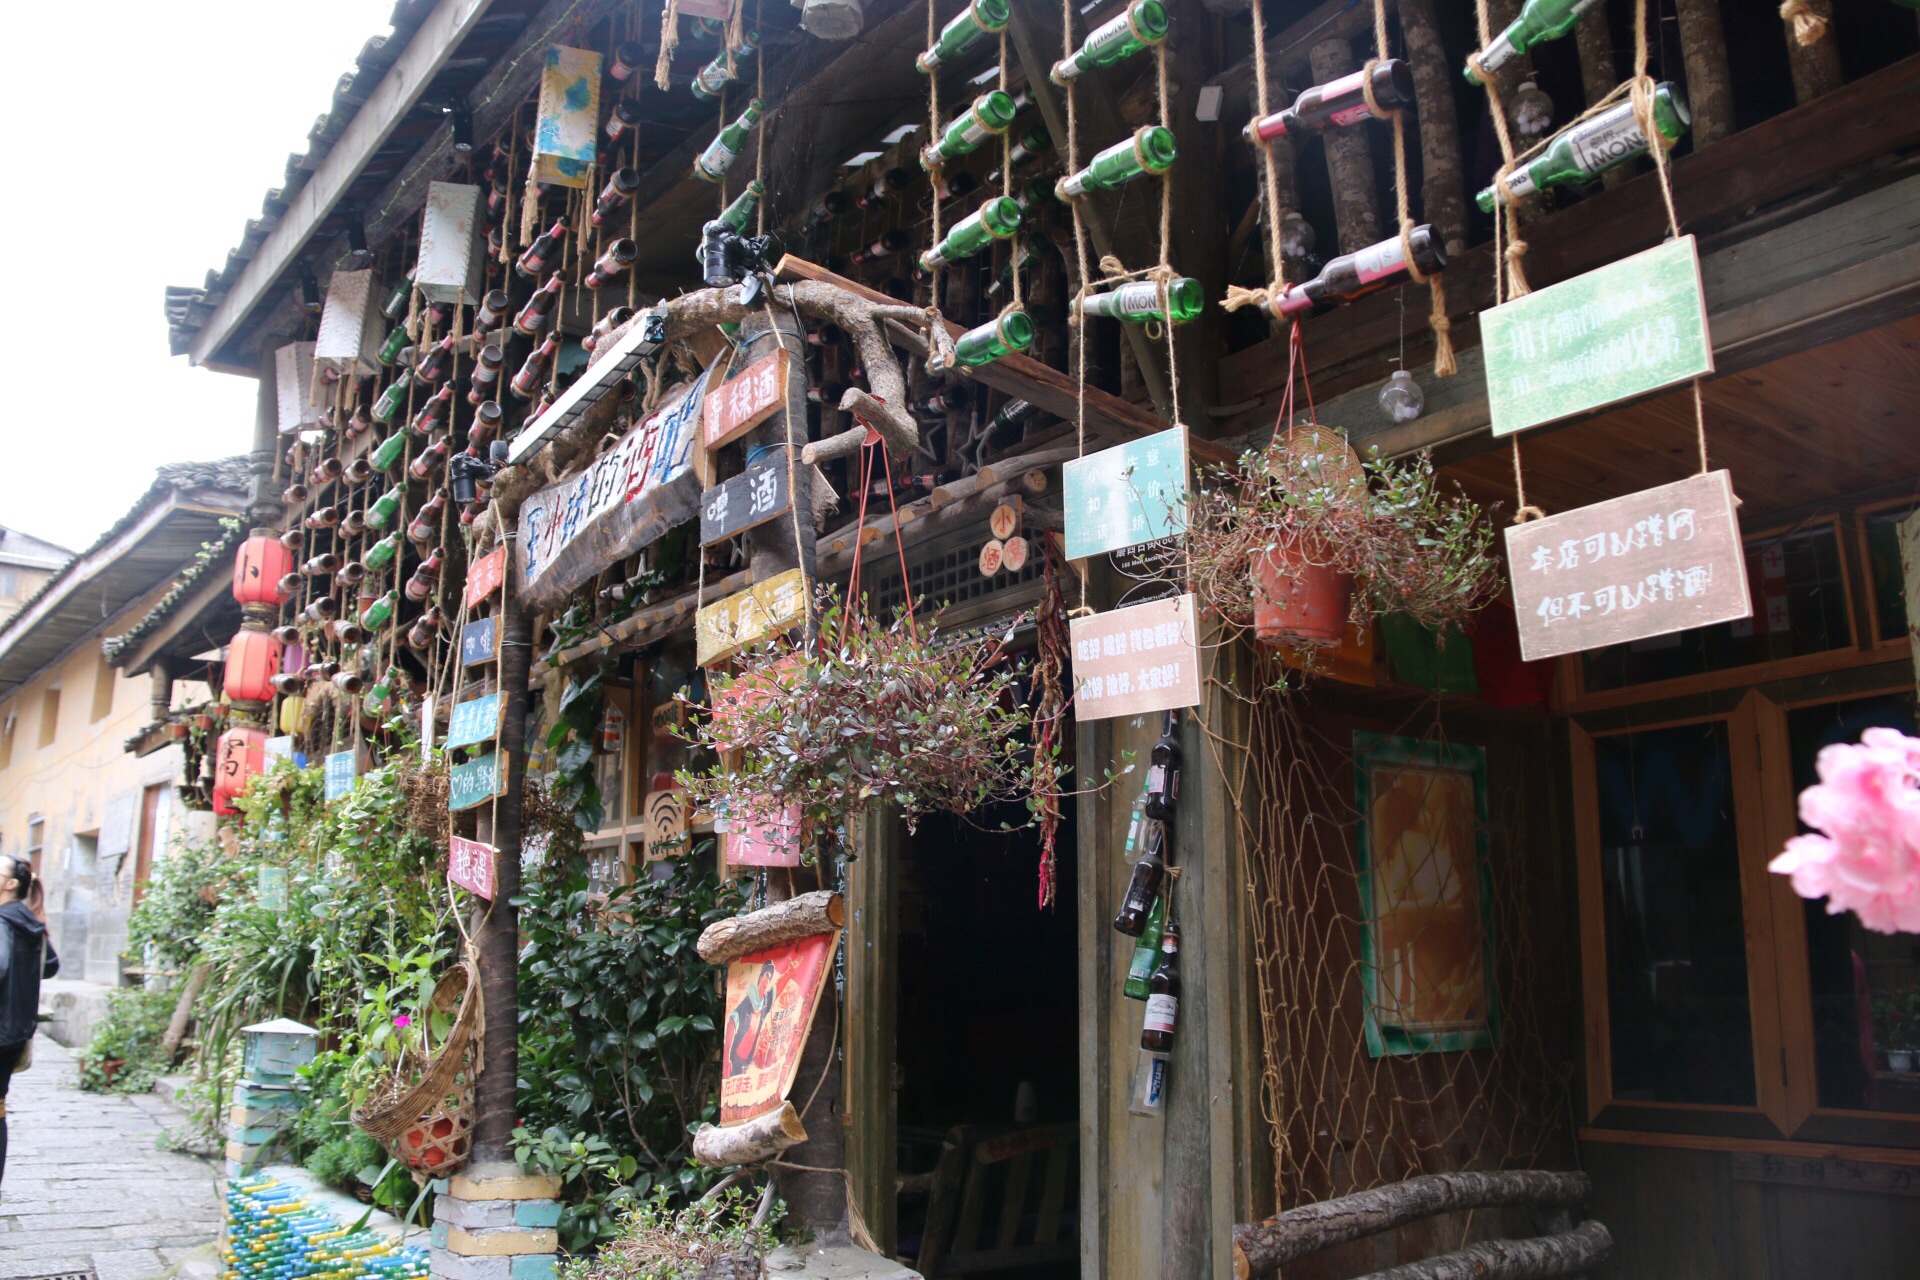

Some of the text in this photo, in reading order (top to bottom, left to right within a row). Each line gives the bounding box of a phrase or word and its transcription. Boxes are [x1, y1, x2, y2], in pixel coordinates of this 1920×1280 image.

[1128, 295, 1158, 310] MON
[707, 362, 776, 440] 青稞酒
[1087, 448, 1160, 483] 小生意
[706, 467, 778, 534] 啤酒
[465, 625, 492, 655] 咖啡
[1077, 637, 1100, 662] 吃好
[1103, 632, 1127, 656] 喝好
[456, 842, 487, 894] 艳遇
